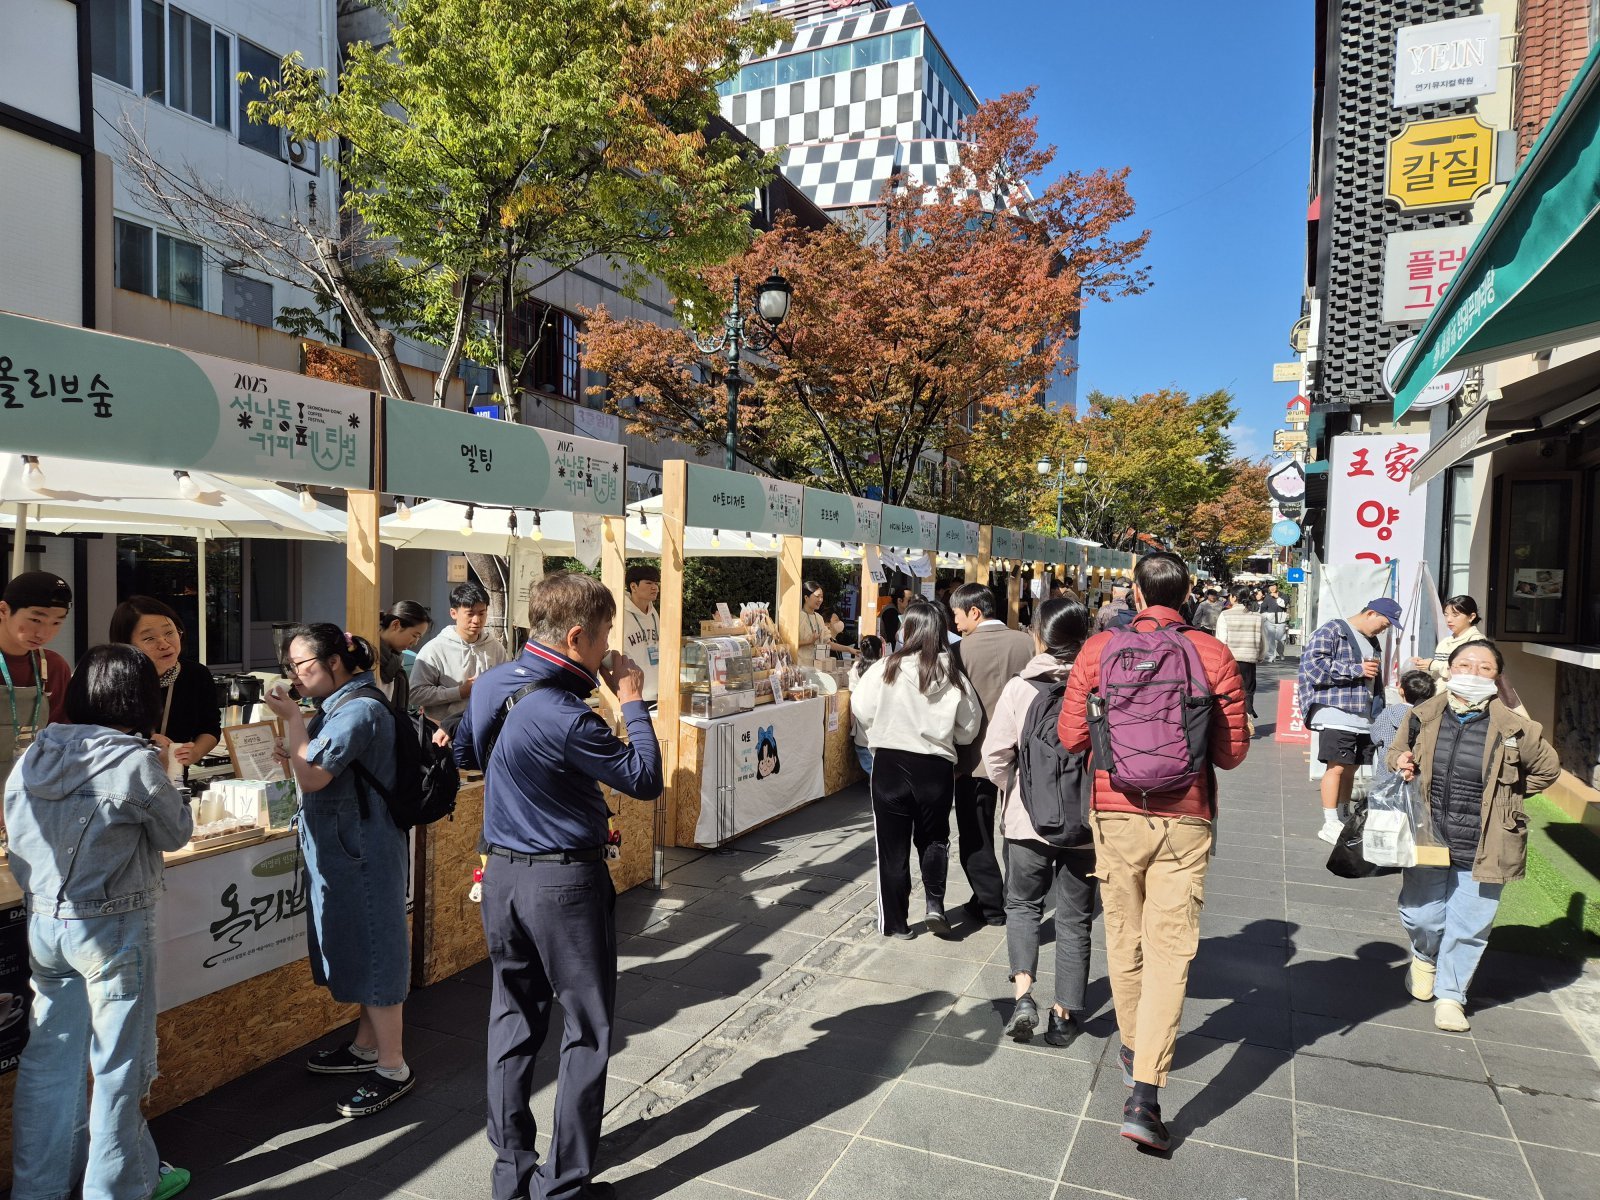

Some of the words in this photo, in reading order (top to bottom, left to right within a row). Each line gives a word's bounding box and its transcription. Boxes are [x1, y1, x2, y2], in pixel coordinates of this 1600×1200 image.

[1407, 38, 1487, 75] YEIN
[1415, 82, 1431, 92] 연기
[1432, 79, 1457, 88] 뮤지컬
[1457, 76, 1475, 86] 학원
[1402, 146, 1479, 192] 칼질
[0, 356, 114, 418] 올리브숲
[233, 373, 268, 394] 2025
[461, 444, 493, 473] 멜팅
[557, 440, 574, 452] 2025
[1347, 442, 1419, 482] 王家
[870, 571, 886, 581] TEA
